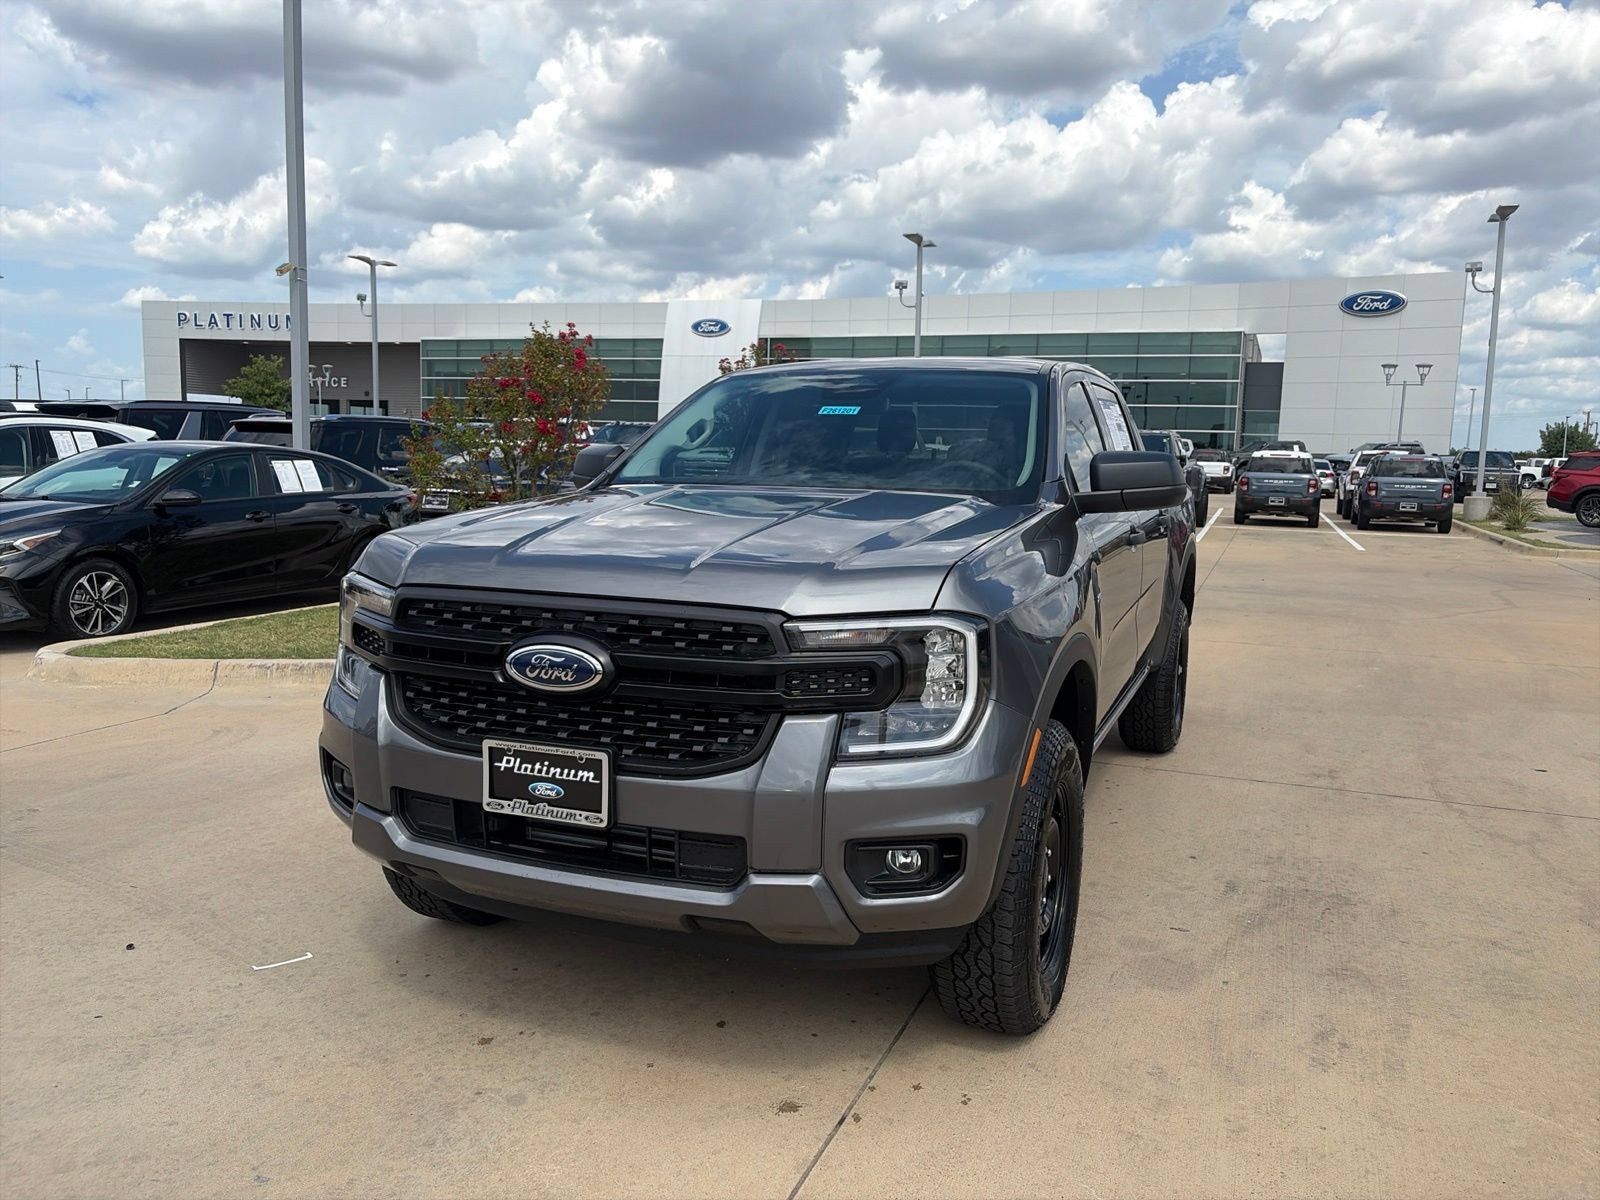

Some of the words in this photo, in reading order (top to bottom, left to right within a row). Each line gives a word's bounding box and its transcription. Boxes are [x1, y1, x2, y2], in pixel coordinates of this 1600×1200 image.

[1353, 295, 1392, 310] Ford
[698, 321, 721, 332] Ford
[525, 654, 578, 682] Ford
[494, 741, 597, 757] www.PlatinumFord.com
[494, 756, 600, 783] Platinum
[535, 784, 558, 797] Ford
[511, 800, 580, 821] Platinum
